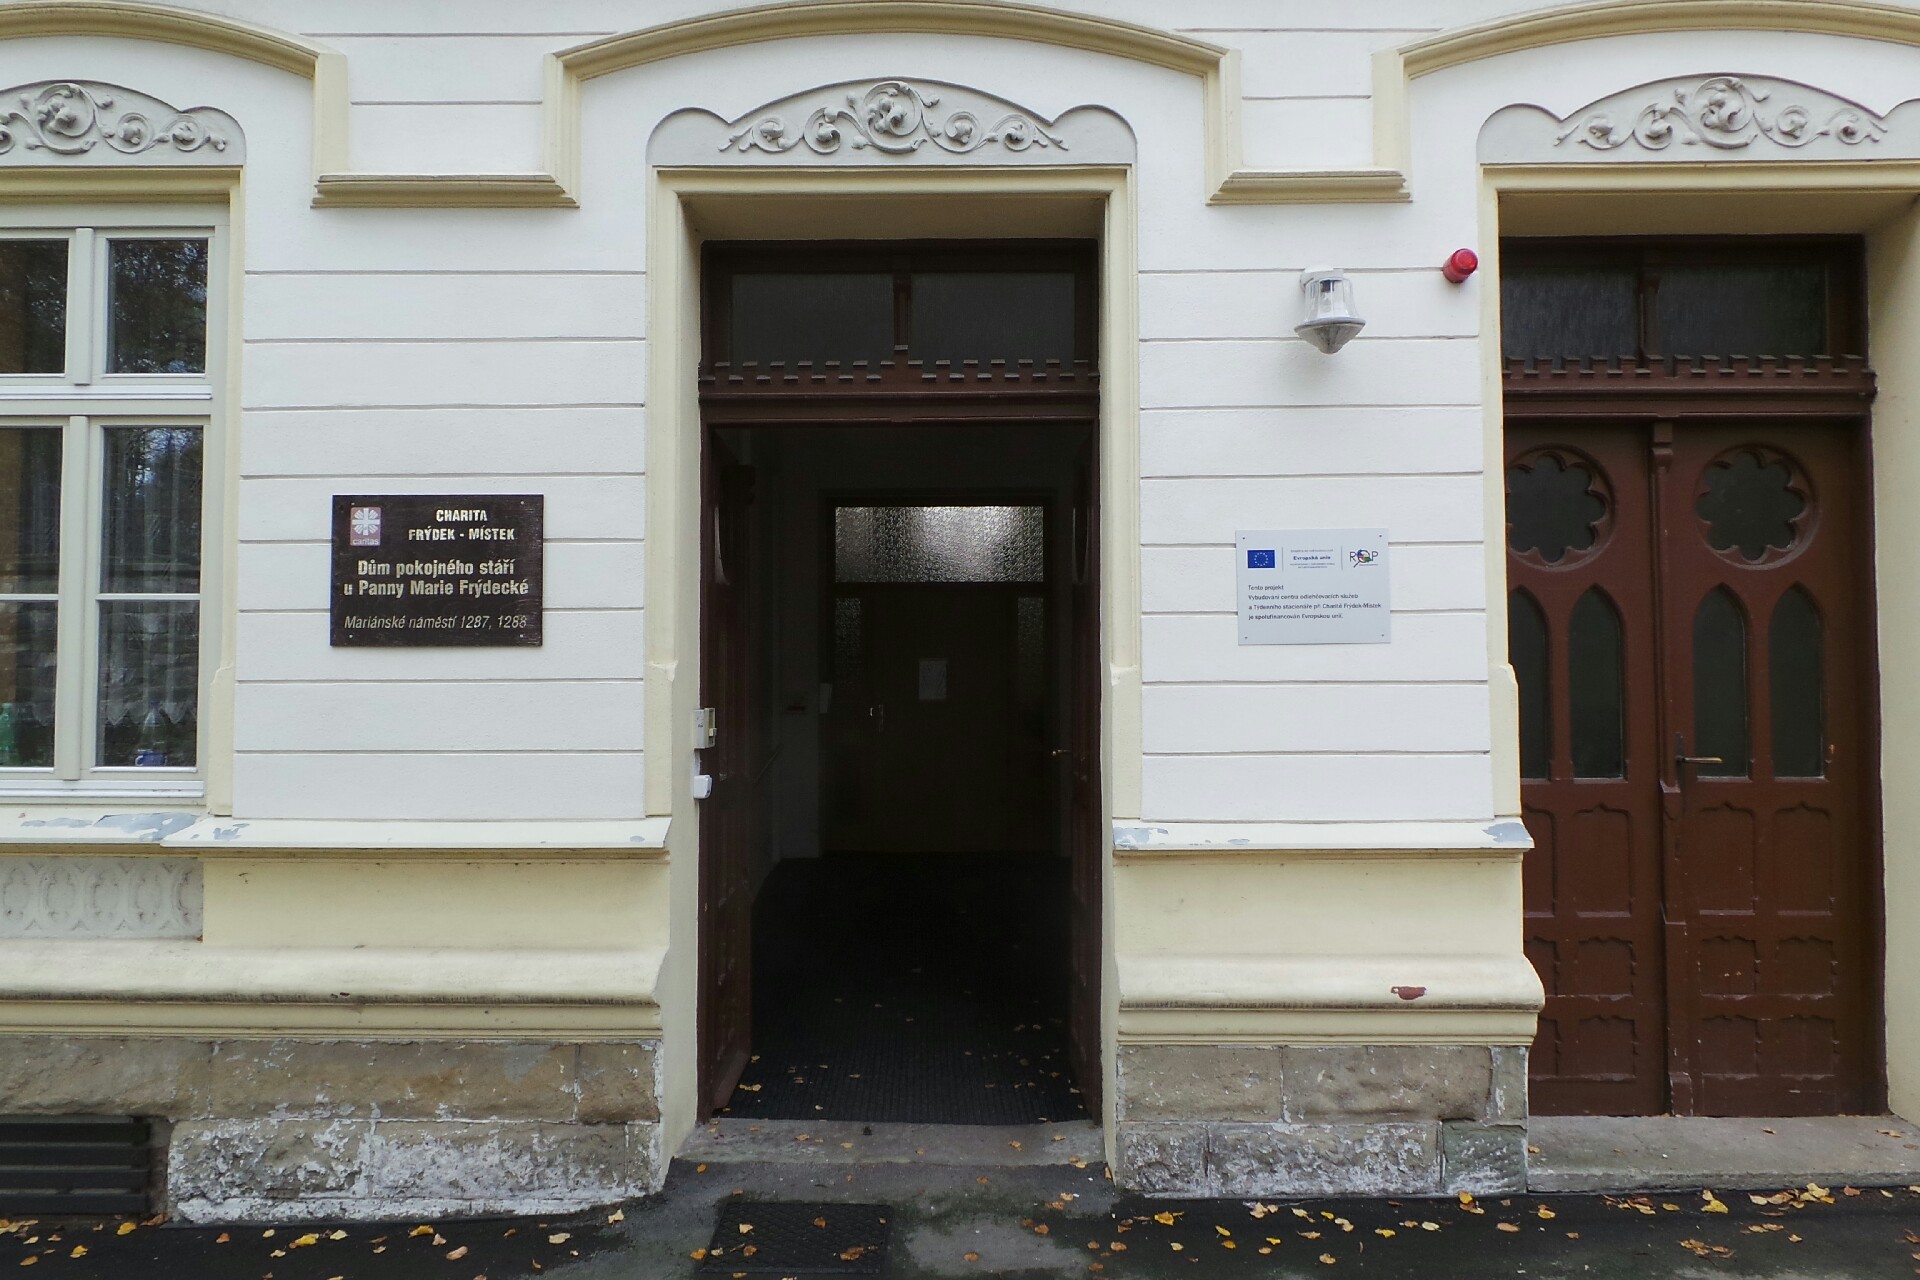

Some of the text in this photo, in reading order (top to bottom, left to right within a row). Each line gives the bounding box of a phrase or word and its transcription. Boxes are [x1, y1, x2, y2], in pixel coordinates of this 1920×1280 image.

[436, 509, 487, 522] CHARITA
[408, 526, 455, 540] FRÝDEK
[469, 525, 515, 540] MÍSTEK
[358, 559, 515, 578] Dům pokojného stáří
[344, 579, 529, 598] u Panny Marie Frýdecké
[344, 616, 527, 630] Mariánské náměstí 1287, 1288
